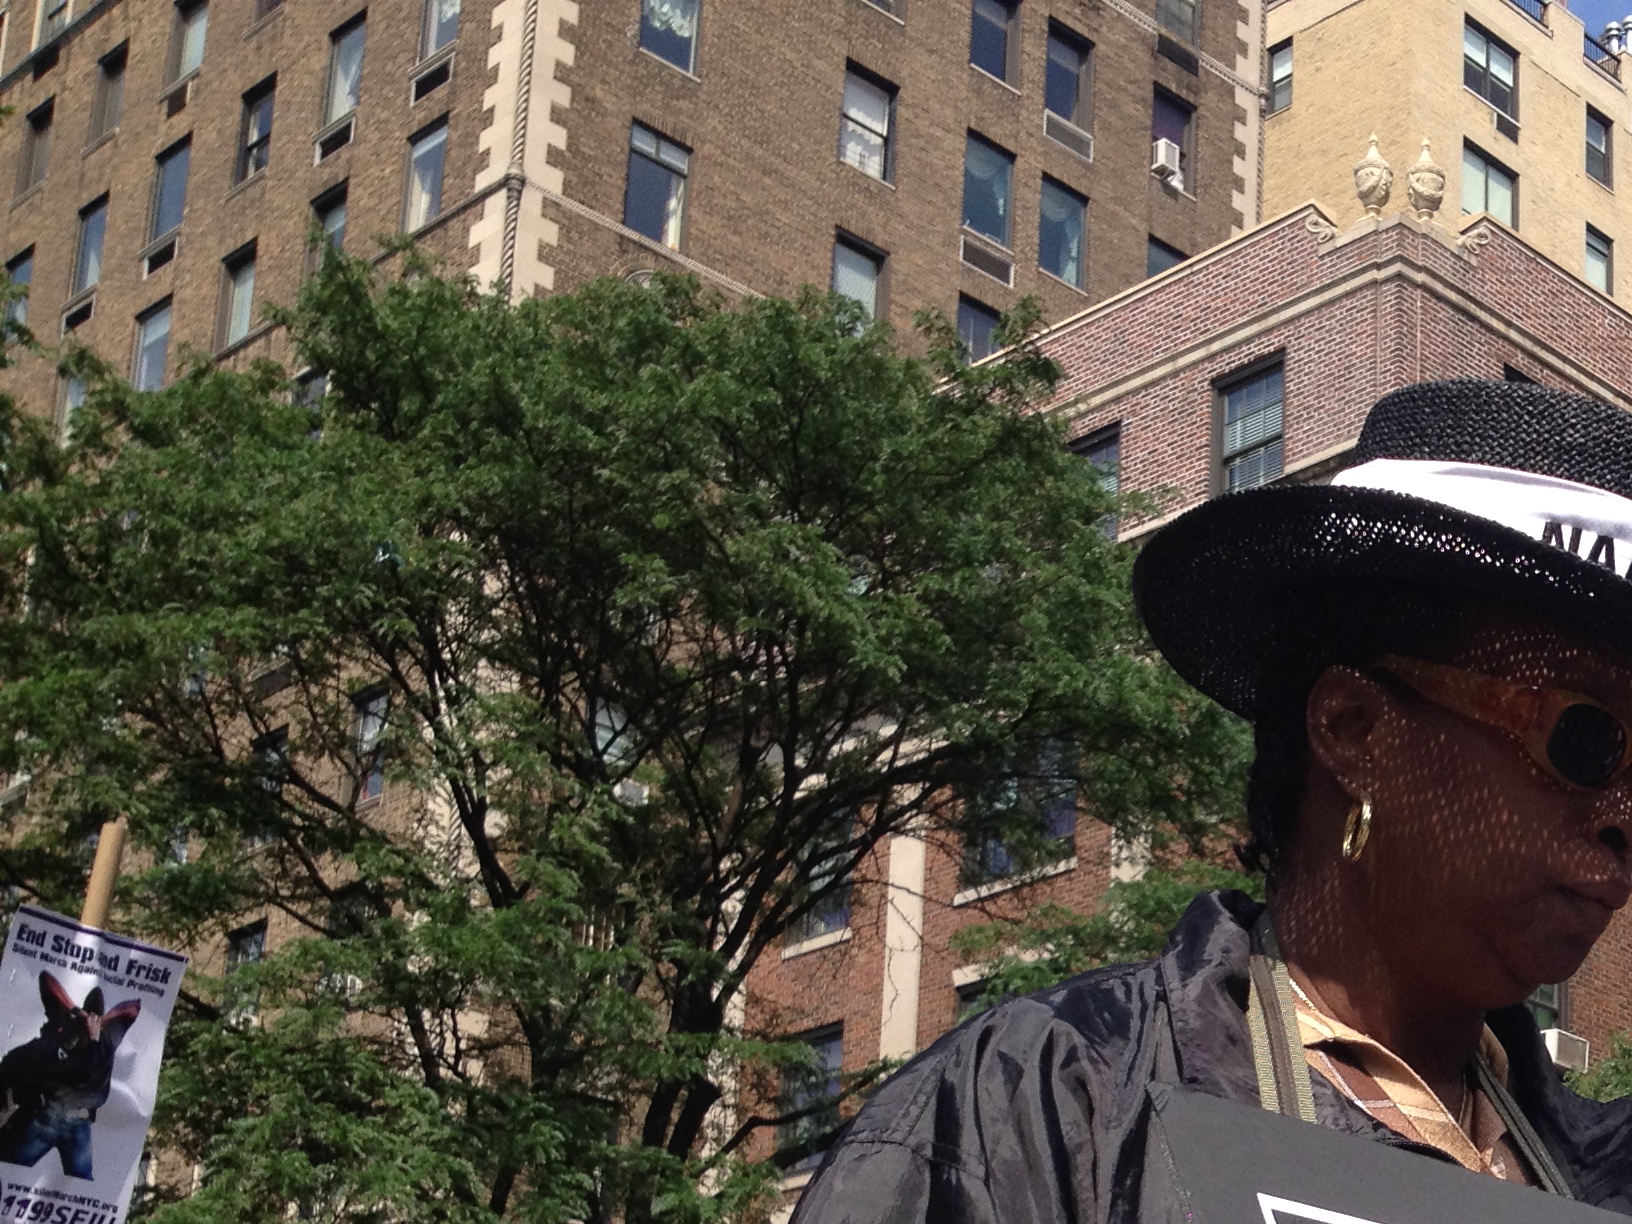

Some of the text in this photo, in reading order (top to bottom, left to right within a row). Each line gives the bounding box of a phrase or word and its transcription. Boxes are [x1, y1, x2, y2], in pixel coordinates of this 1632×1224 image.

[15, 923, 47, 948] End
[51, 934, 95, 964] Stop
[125, 957, 172, 985] Frisk
